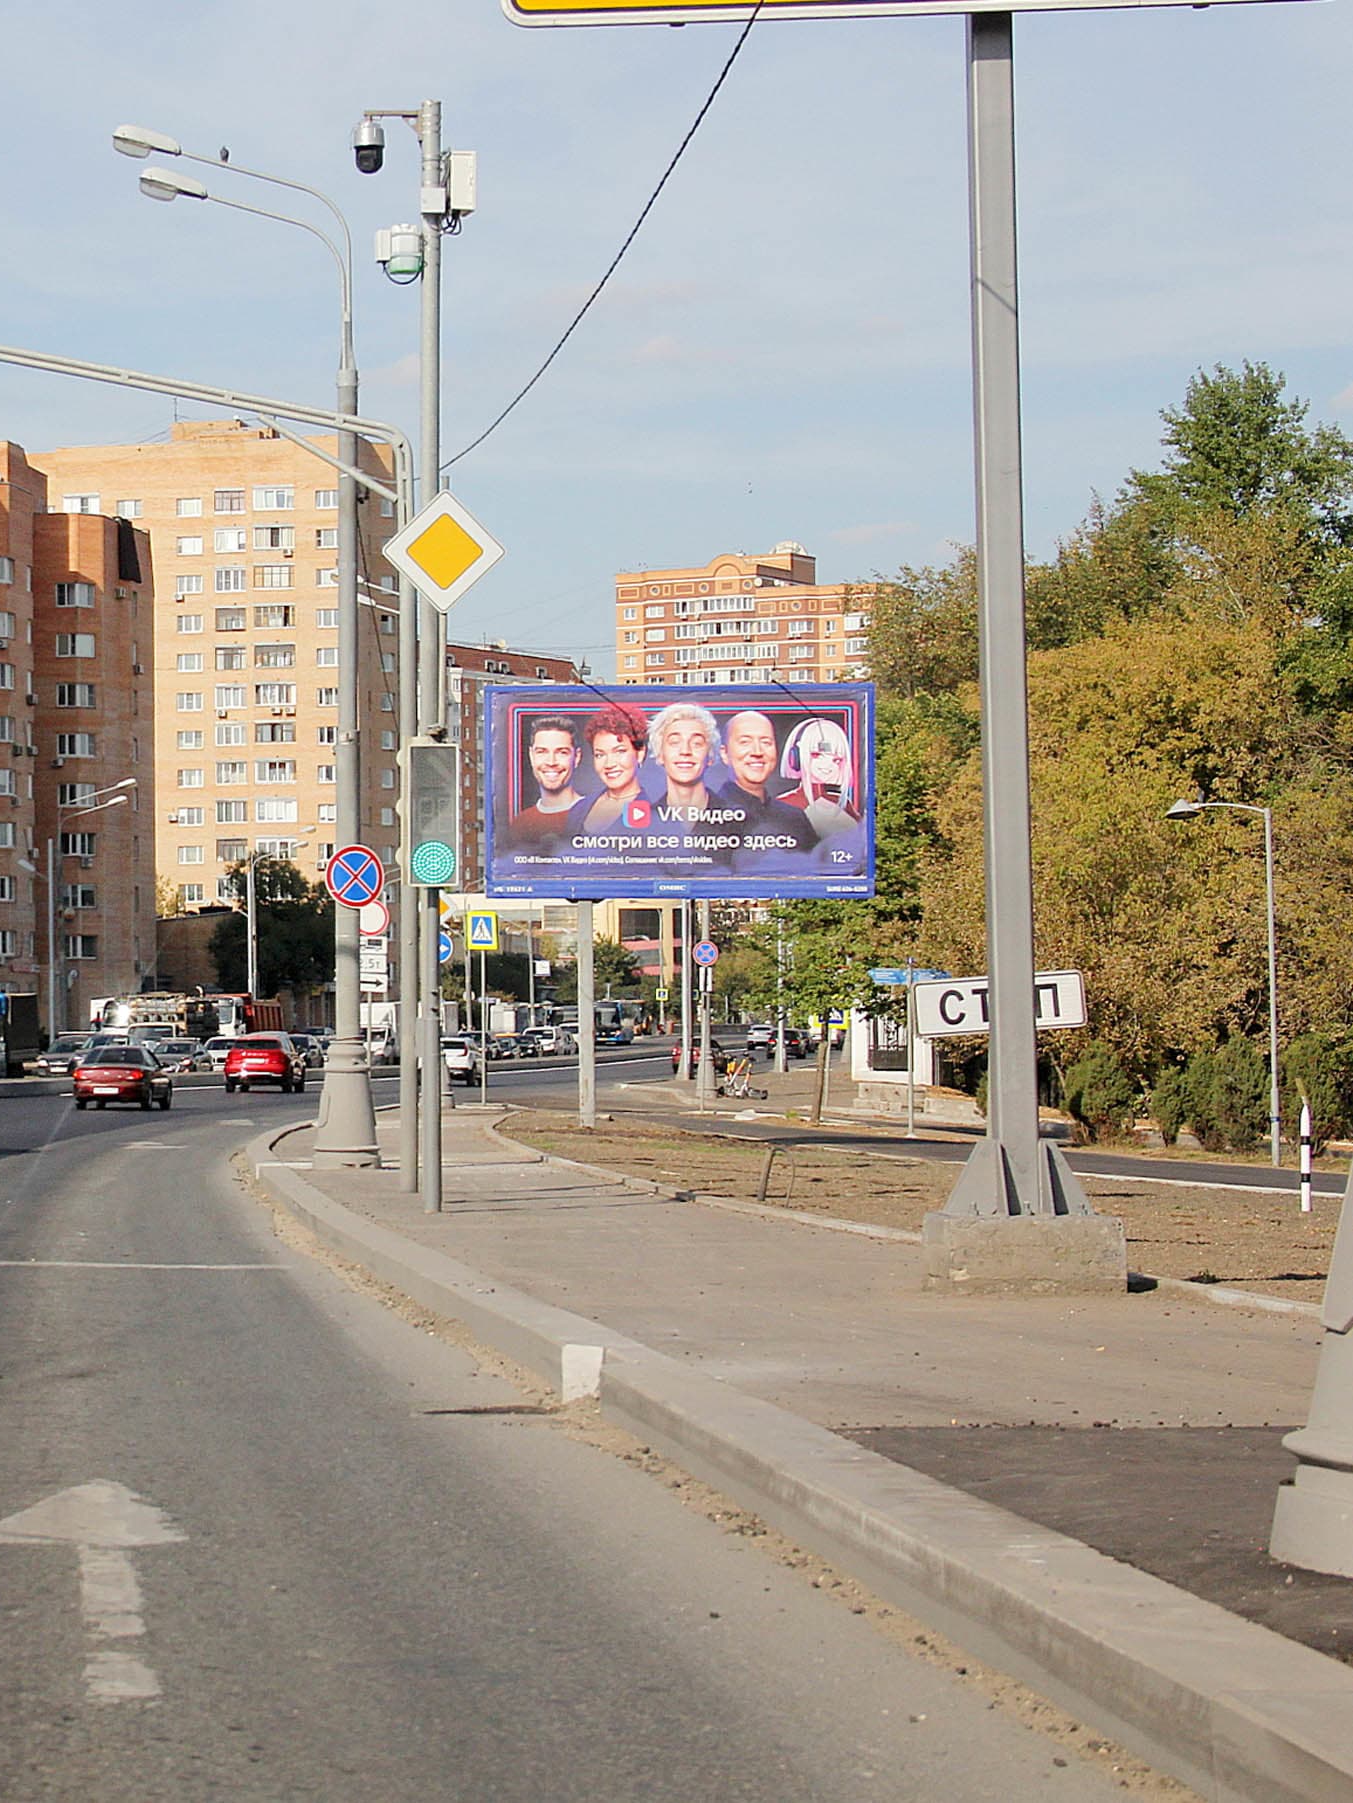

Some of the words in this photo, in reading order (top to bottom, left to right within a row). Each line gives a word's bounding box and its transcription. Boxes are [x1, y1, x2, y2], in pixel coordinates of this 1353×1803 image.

[657, 806, 684, 821] VK
[687, 806, 746, 824] Видео
[571, 835, 642, 852] смотри
[646, 835, 680, 849] все
[683, 836, 740, 851] видео
[743, 835, 797, 850] здесь
[831, 851, 853, 863] 12+
[938, 983, 1061, 1026] СТП
